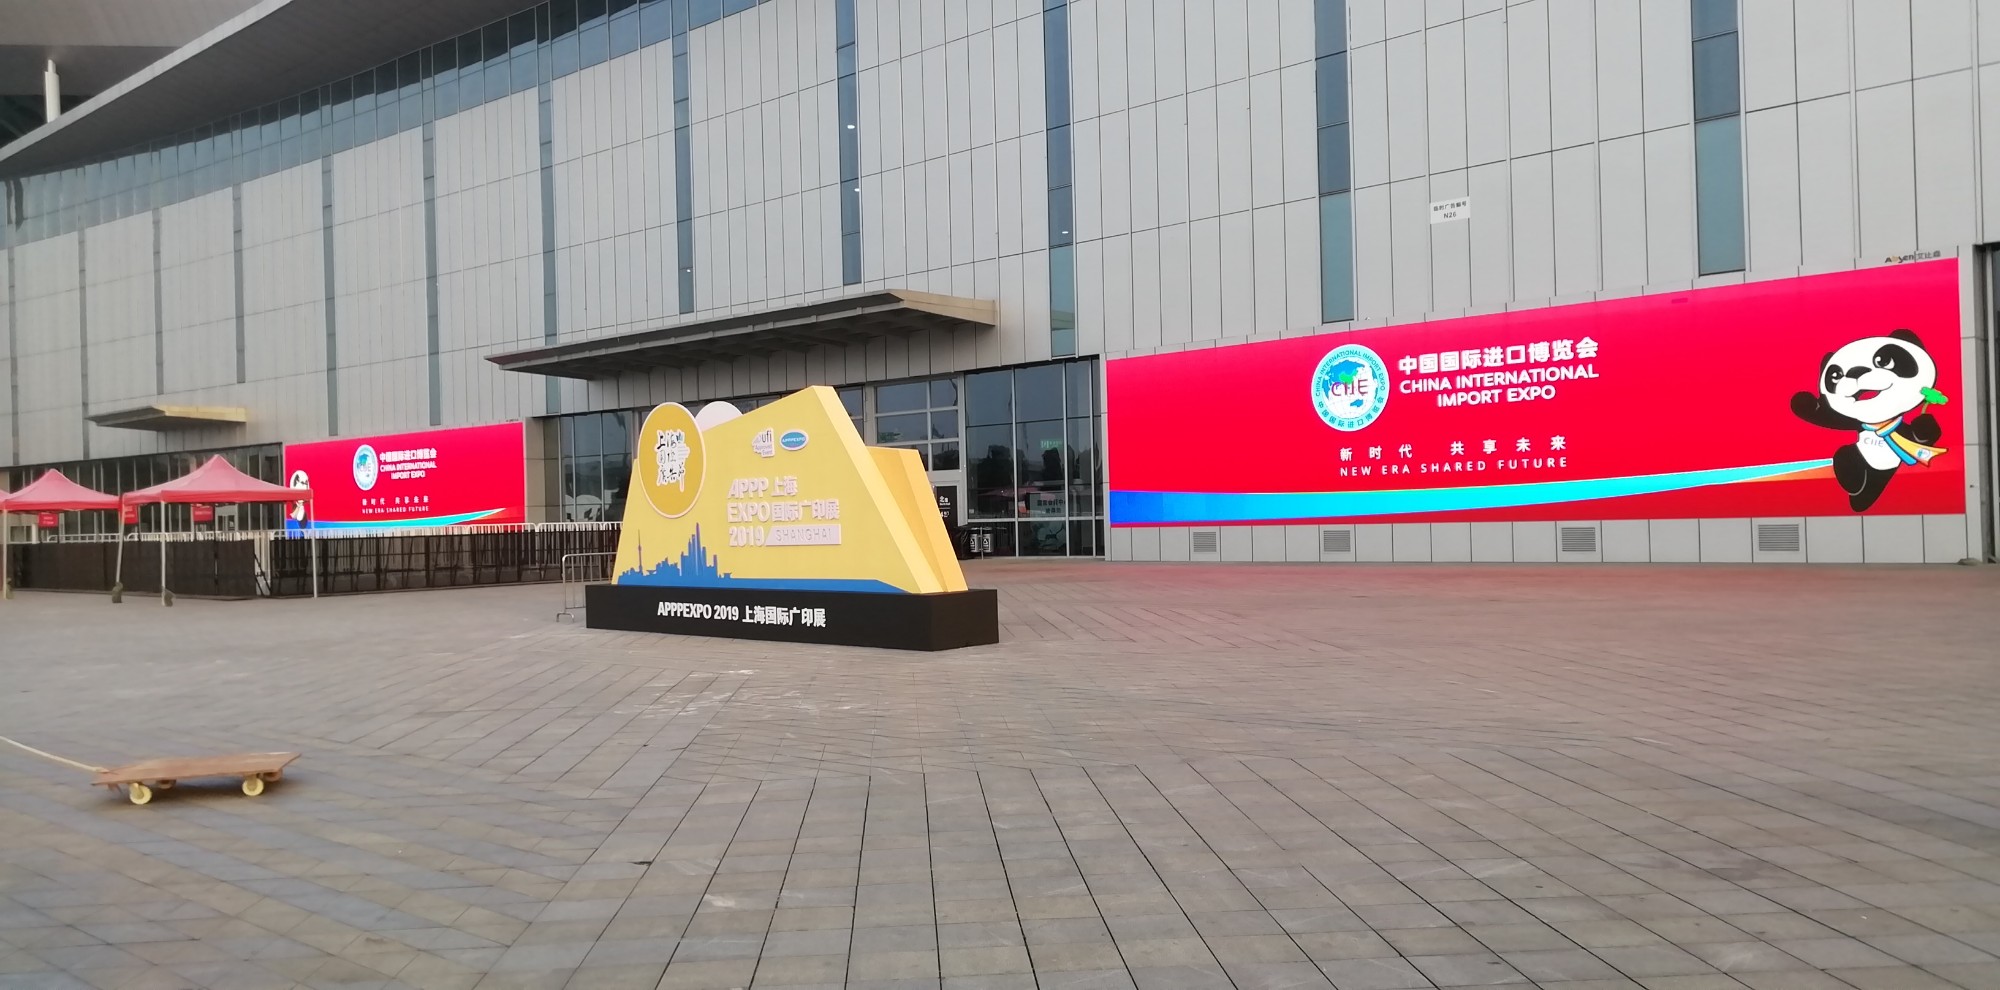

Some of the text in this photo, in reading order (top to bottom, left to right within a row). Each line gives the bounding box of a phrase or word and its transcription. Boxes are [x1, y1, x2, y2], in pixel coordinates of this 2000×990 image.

[1443, 211, 1457, 219] N26
[1398, 336, 1599, 375] 中国国际进口博览会
[1400, 364, 1600, 394] CHINA INTERNATIONAL
[1437, 384, 1557, 408] IMPORT EXPO
[1340, 435, 1567, 462] 新时代 共享未来
[1863, 437, 1884, 448] CIIE
[1340, 456, 1568, 477] NEW ERA SHARED FUTURE
[727, 475, 798, 499] APPP 上海
[727, 498, 840, 523] EXPO 国际广印展
[729, 525, 832, 547] 2019 SHANGHAI
[657, 601, 827, 628] APPPEXPO 2019 上海国际广印展
